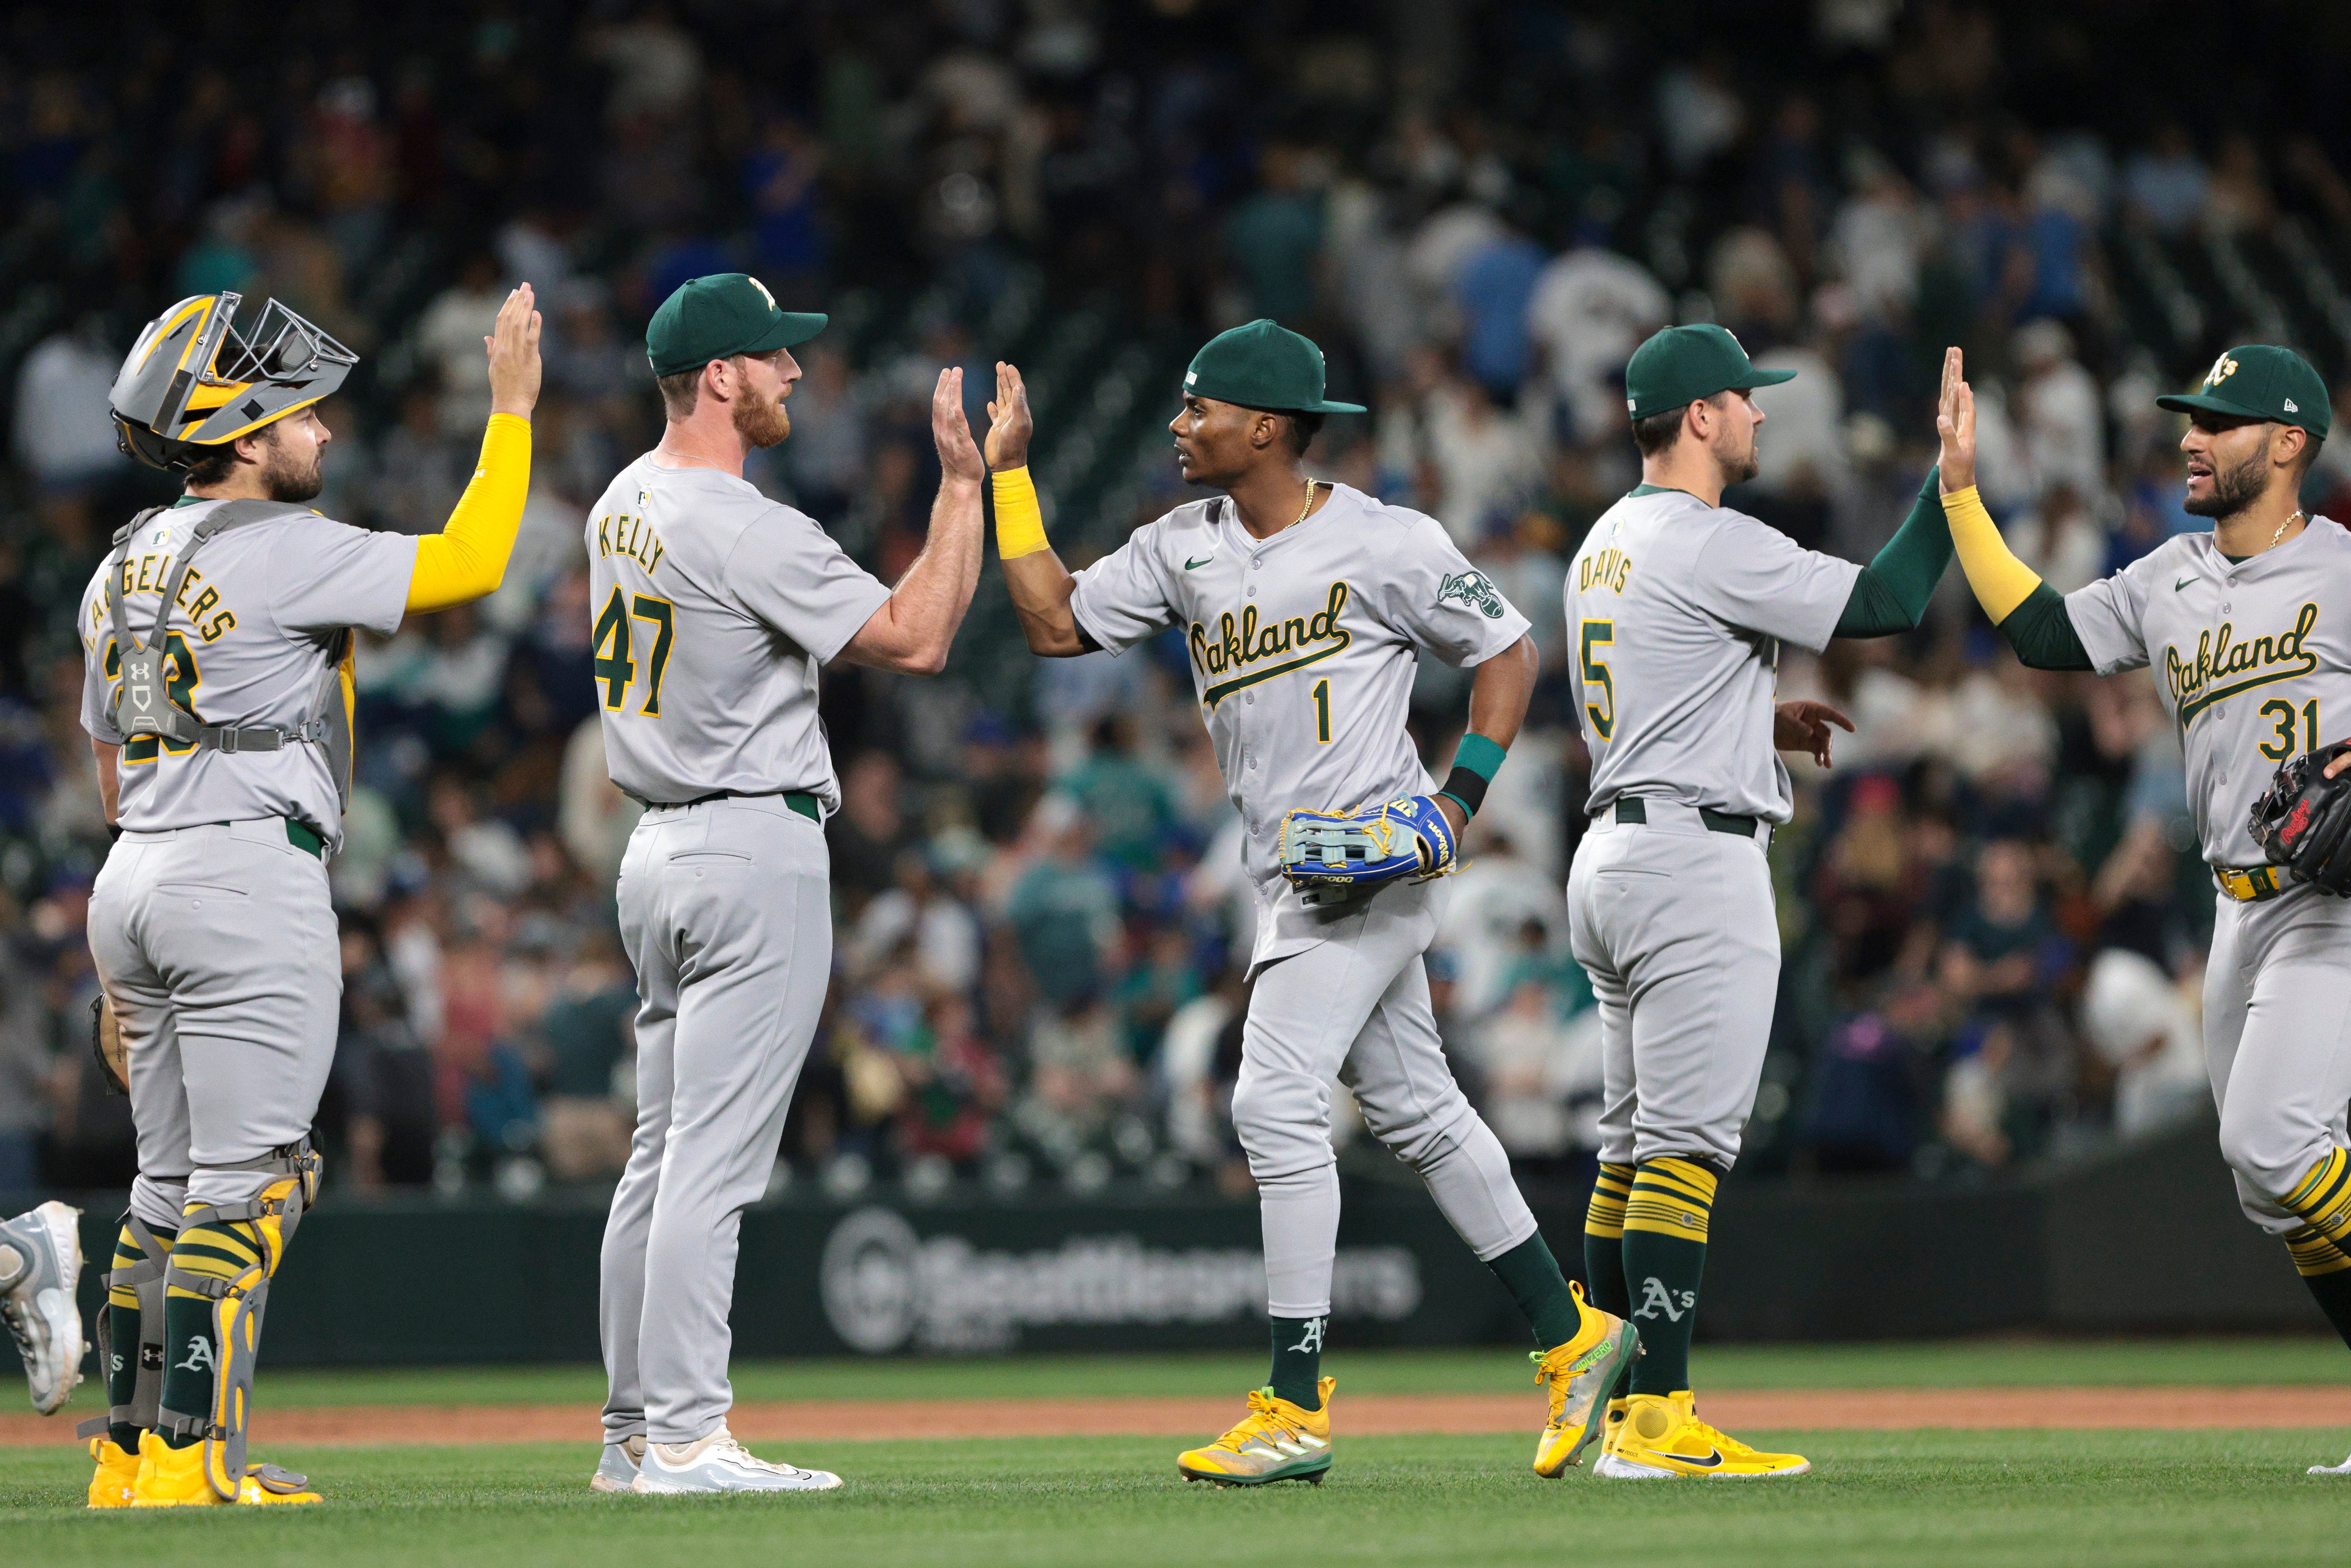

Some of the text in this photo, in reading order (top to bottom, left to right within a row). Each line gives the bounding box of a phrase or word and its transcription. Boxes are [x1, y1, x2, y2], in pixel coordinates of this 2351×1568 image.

[598, 514, 664, 577] KELLY
[1580, 547, 1632, 596] DAVIS
[85, 553, 238, 656] LAGELERS
[1191, 581, 1351, 676] Oakland
[592, 582, 676, 718] 47
[1579, 619, 1616, 742] 5
[2167, 601, 2319, 702] Oakland
[1312, 678, 1332, 743] 1
[2258, 698, 2319, 761] 31
[1427, 820, 1449, 866] Wilson
[2281, 799, 2311, 844] Rawlings
[1635, 1277, 1694, 1322] A's
[1576, 1340, 1612, 1372] ADIZERO
